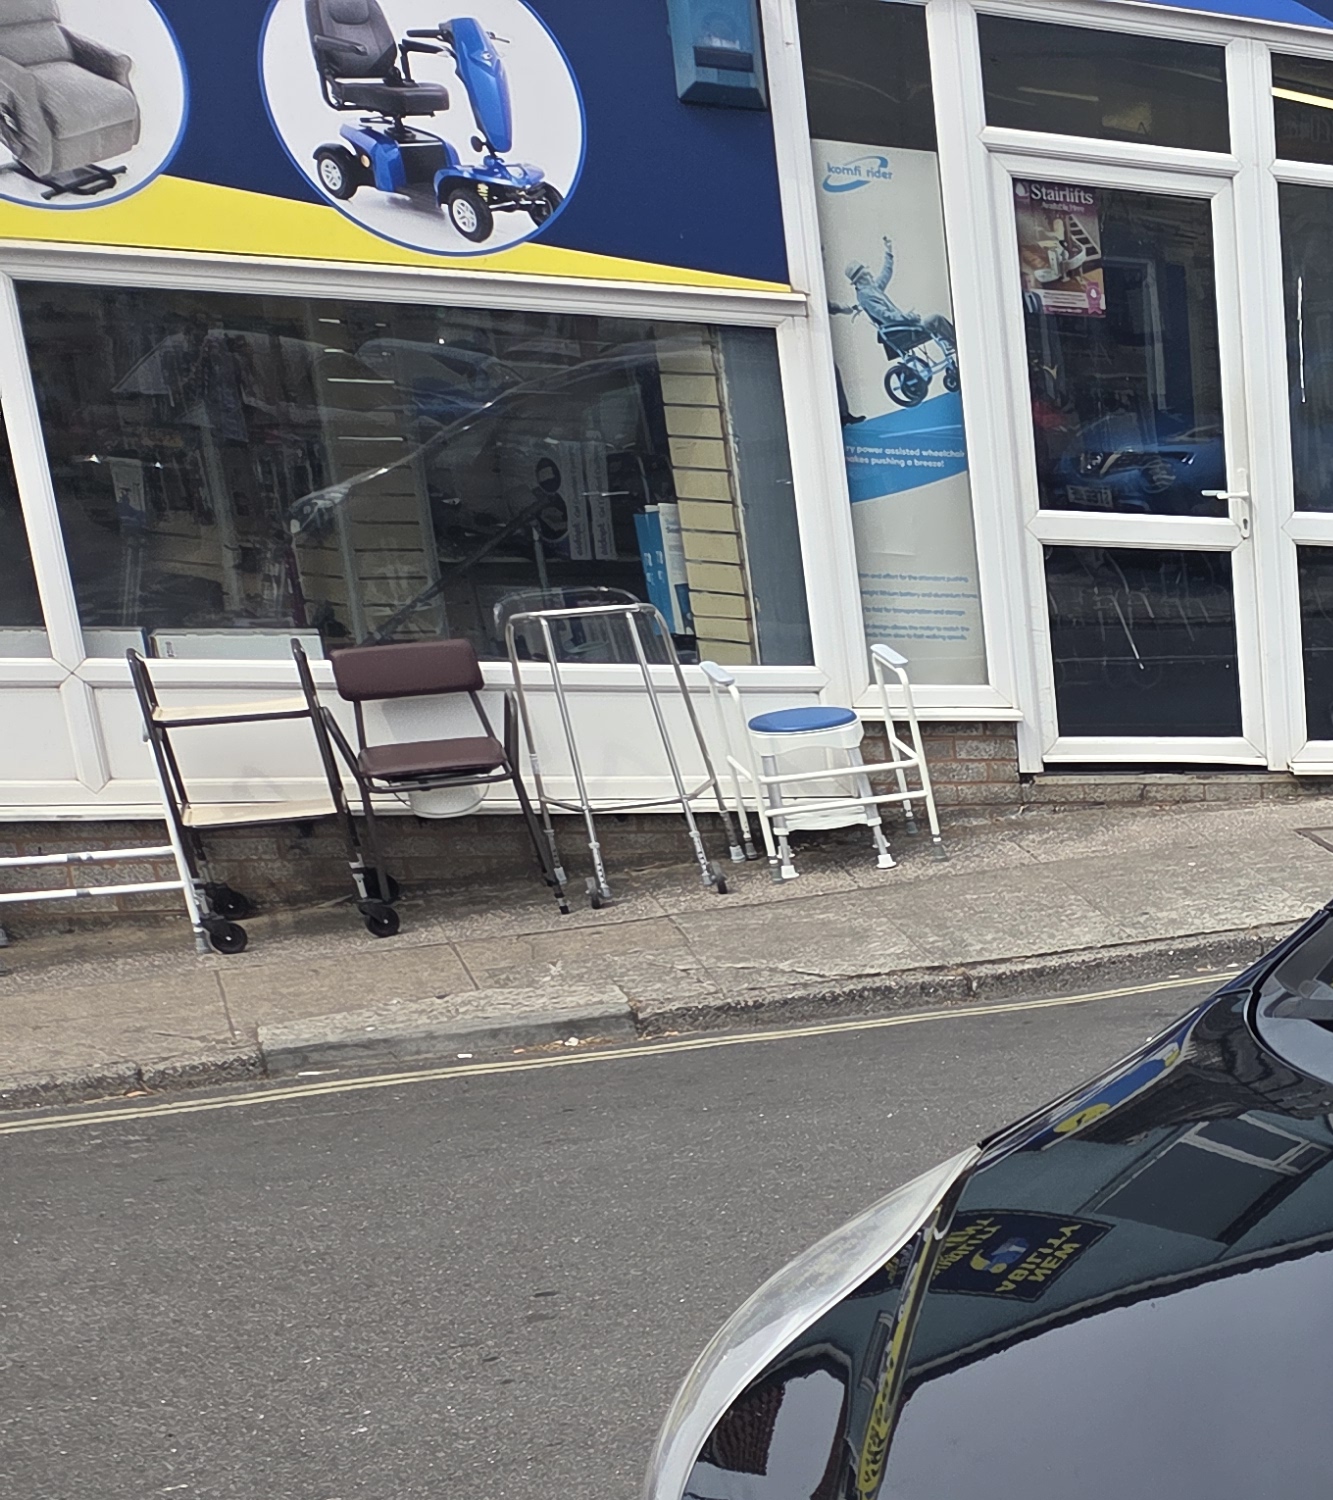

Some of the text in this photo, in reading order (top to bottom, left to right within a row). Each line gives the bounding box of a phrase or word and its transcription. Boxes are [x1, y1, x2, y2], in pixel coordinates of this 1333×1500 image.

[827, 162, 893, 180] komfi rider
[1030, 183, 1094, 205] Stairlifts
[857, 446, 883, 454] power
[885, 447, 920, 456] assisted
[871, 457, 905, 468] pushing
